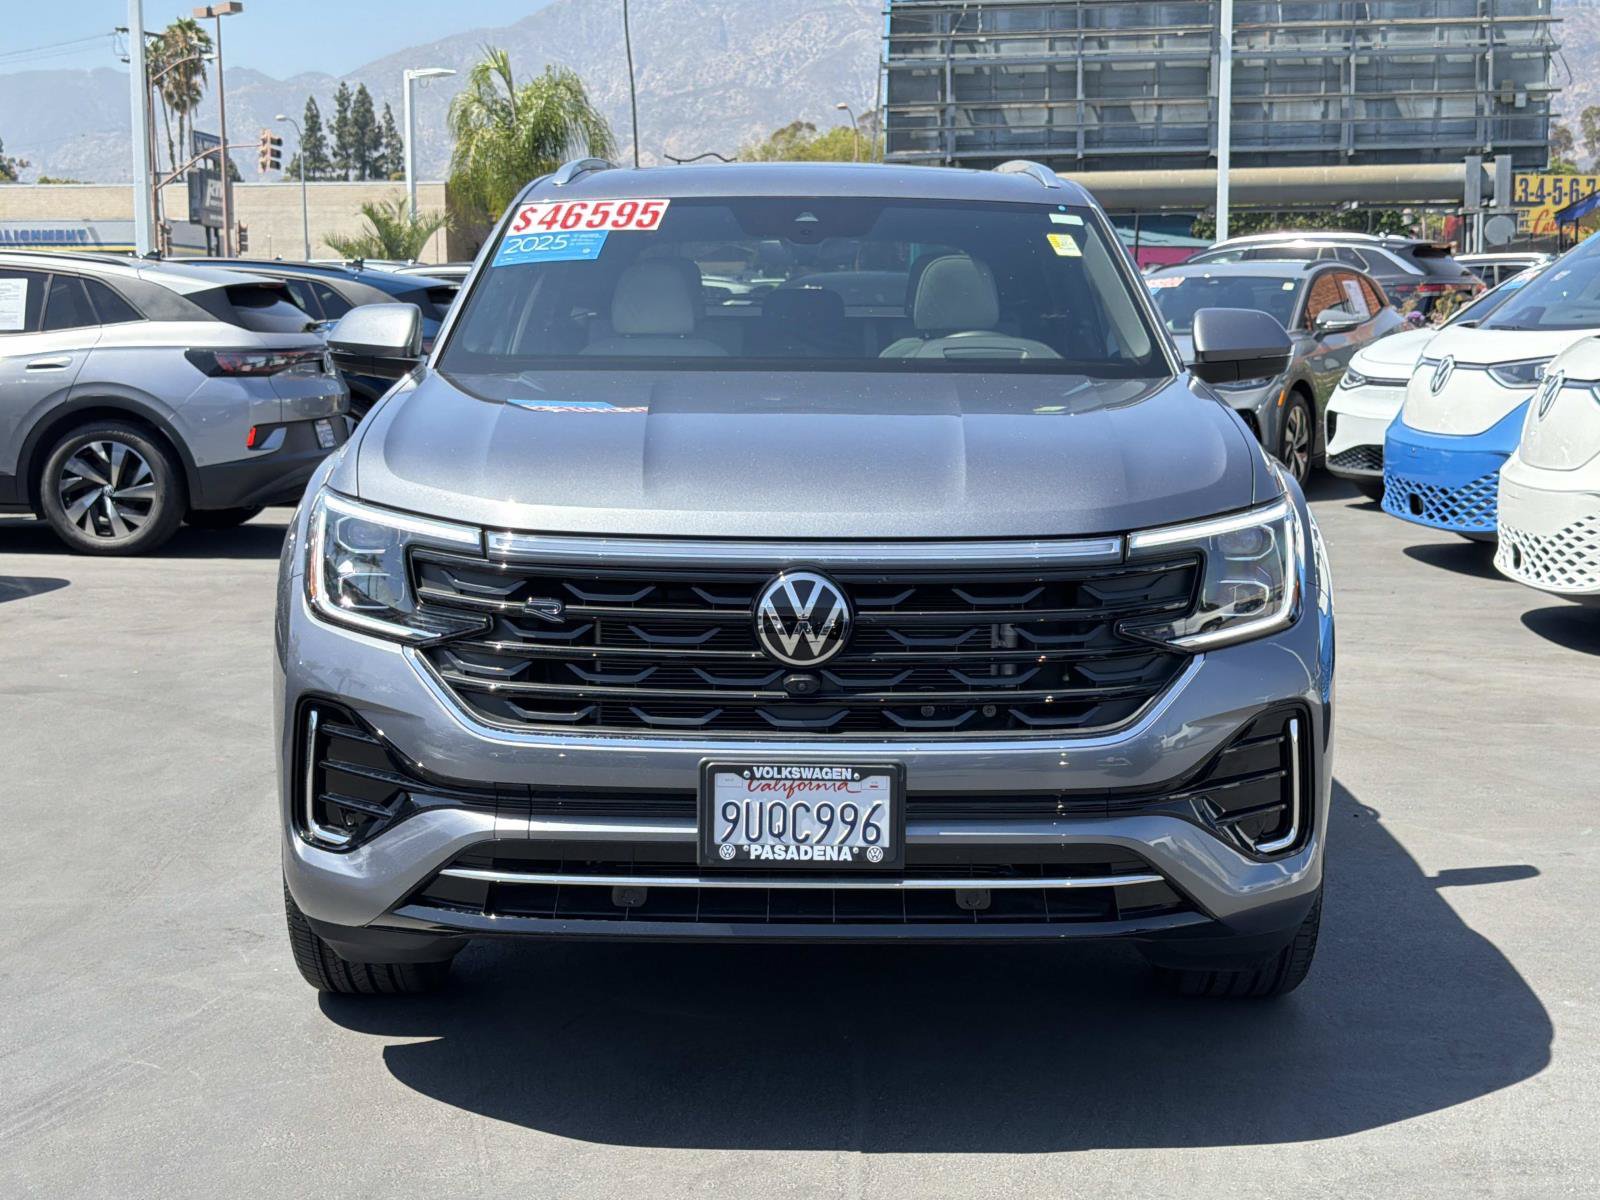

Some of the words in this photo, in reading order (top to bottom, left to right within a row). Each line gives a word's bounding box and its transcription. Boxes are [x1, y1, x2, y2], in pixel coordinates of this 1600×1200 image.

[513, 201, 665, 231] $46595
[0, 229, 88, 242] LIGNMENT
[503, 234, 571, 255] 2025
[753, 767, 852, 780] VOLKSWAGEN
[747, 779, 862, 799] California
[720, 800, 883, 845] 9UQC996
[750, 844, 853, 861] PASADENA
